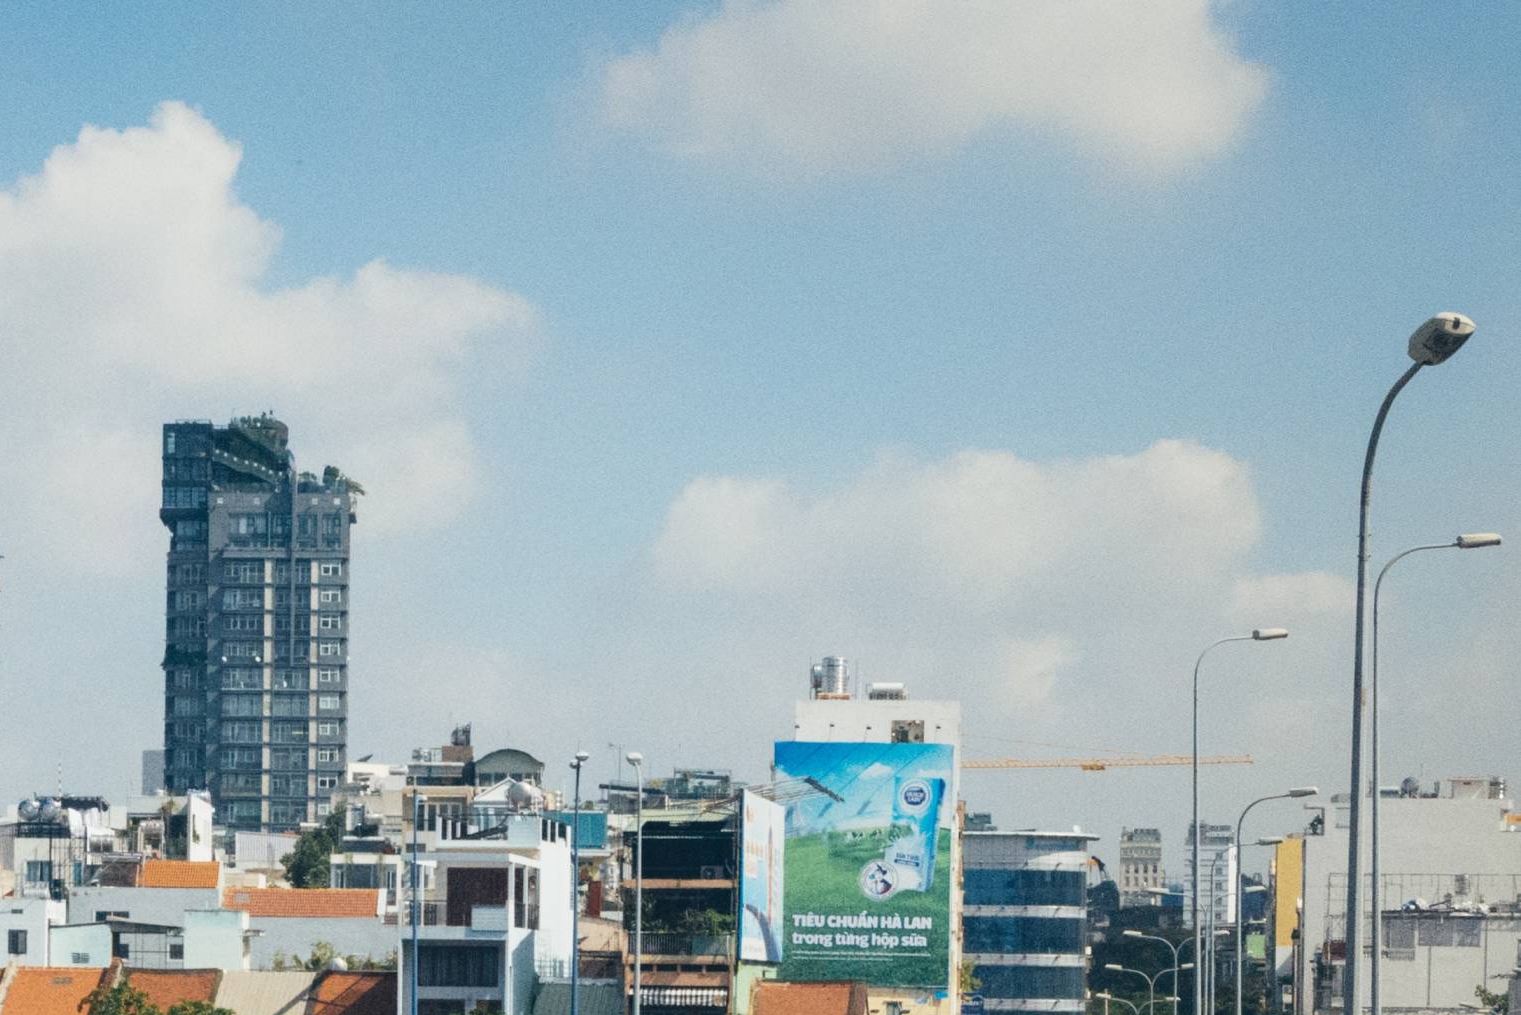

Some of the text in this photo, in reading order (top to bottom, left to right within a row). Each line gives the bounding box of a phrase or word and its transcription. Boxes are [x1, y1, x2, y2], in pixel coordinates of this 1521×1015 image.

[791, 911, 825, 928] TIÊU
[880, 913, 903, 929] HÀ
[903, 916, 932, 930] LAN
[791, 931, 833, 947] trong
[871, 932, 899, 949] hộp
[901, 933, 927, 947] sữa
